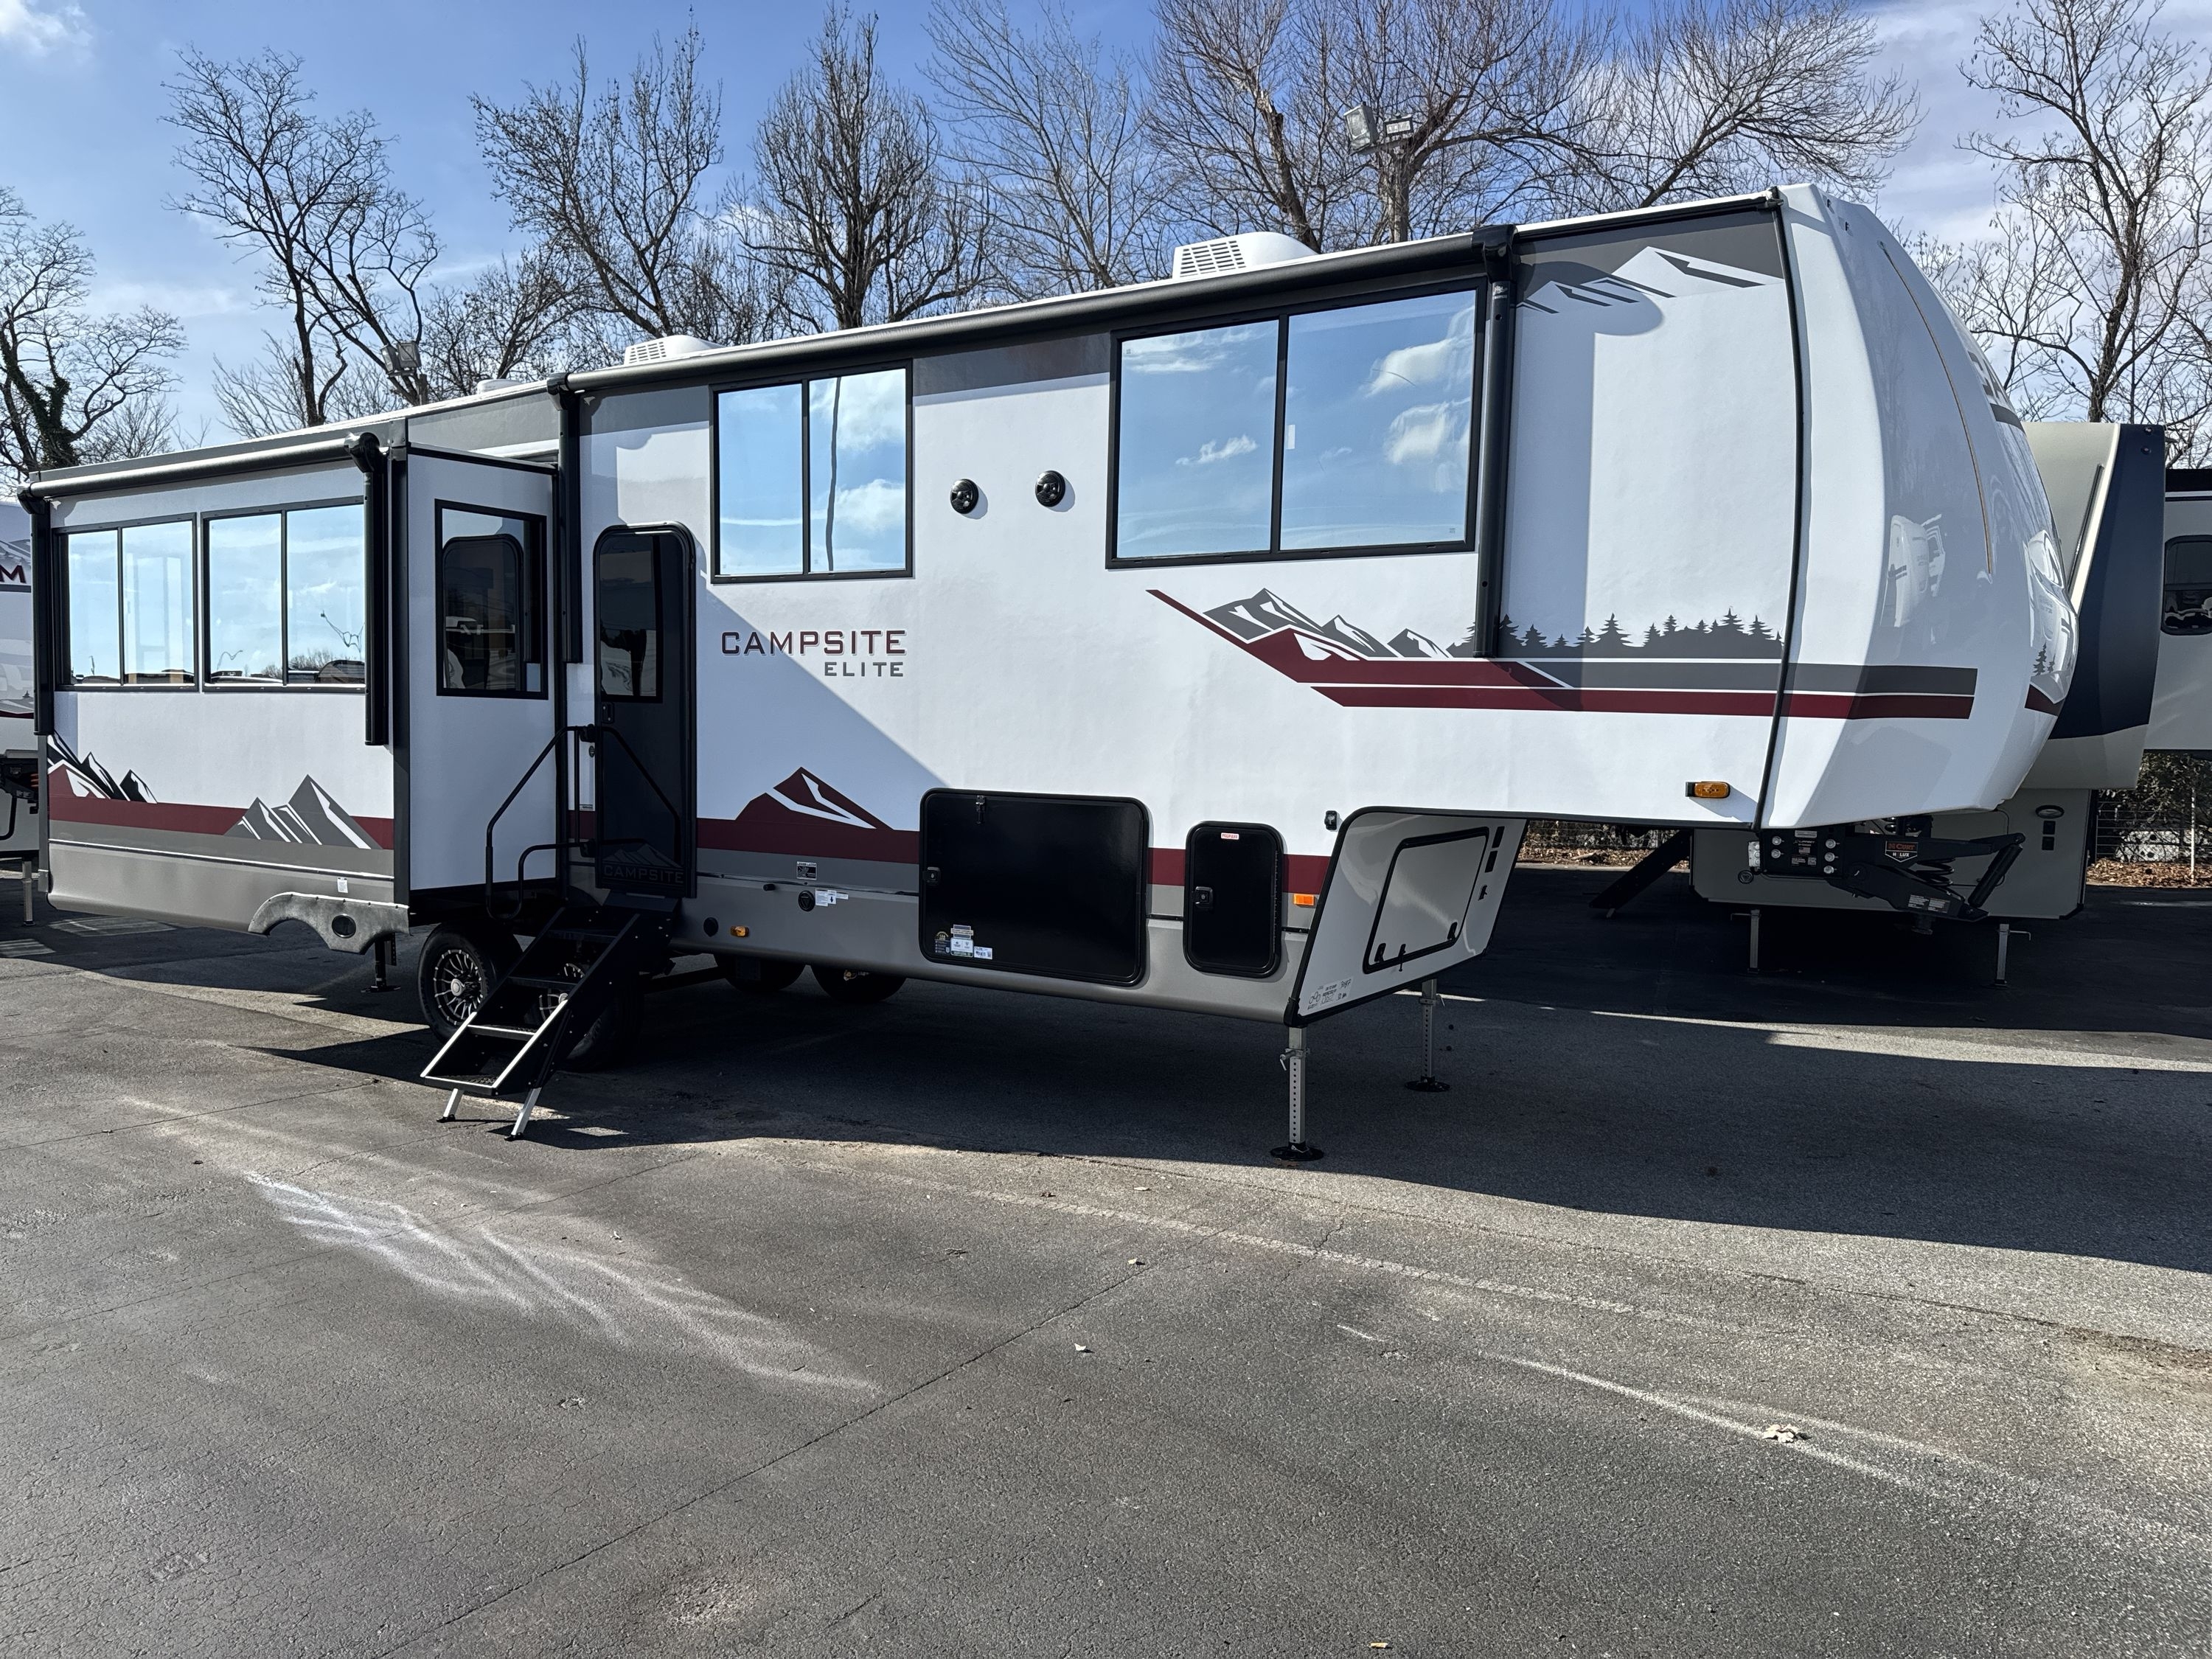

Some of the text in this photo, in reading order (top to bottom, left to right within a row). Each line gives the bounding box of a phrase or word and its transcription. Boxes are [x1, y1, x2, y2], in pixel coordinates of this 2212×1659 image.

[721, 630, 907, 655] CAMPSITE
[824, 661, 904, 677] ELITE
[603, 864, 684, 884] CAMPSITE
